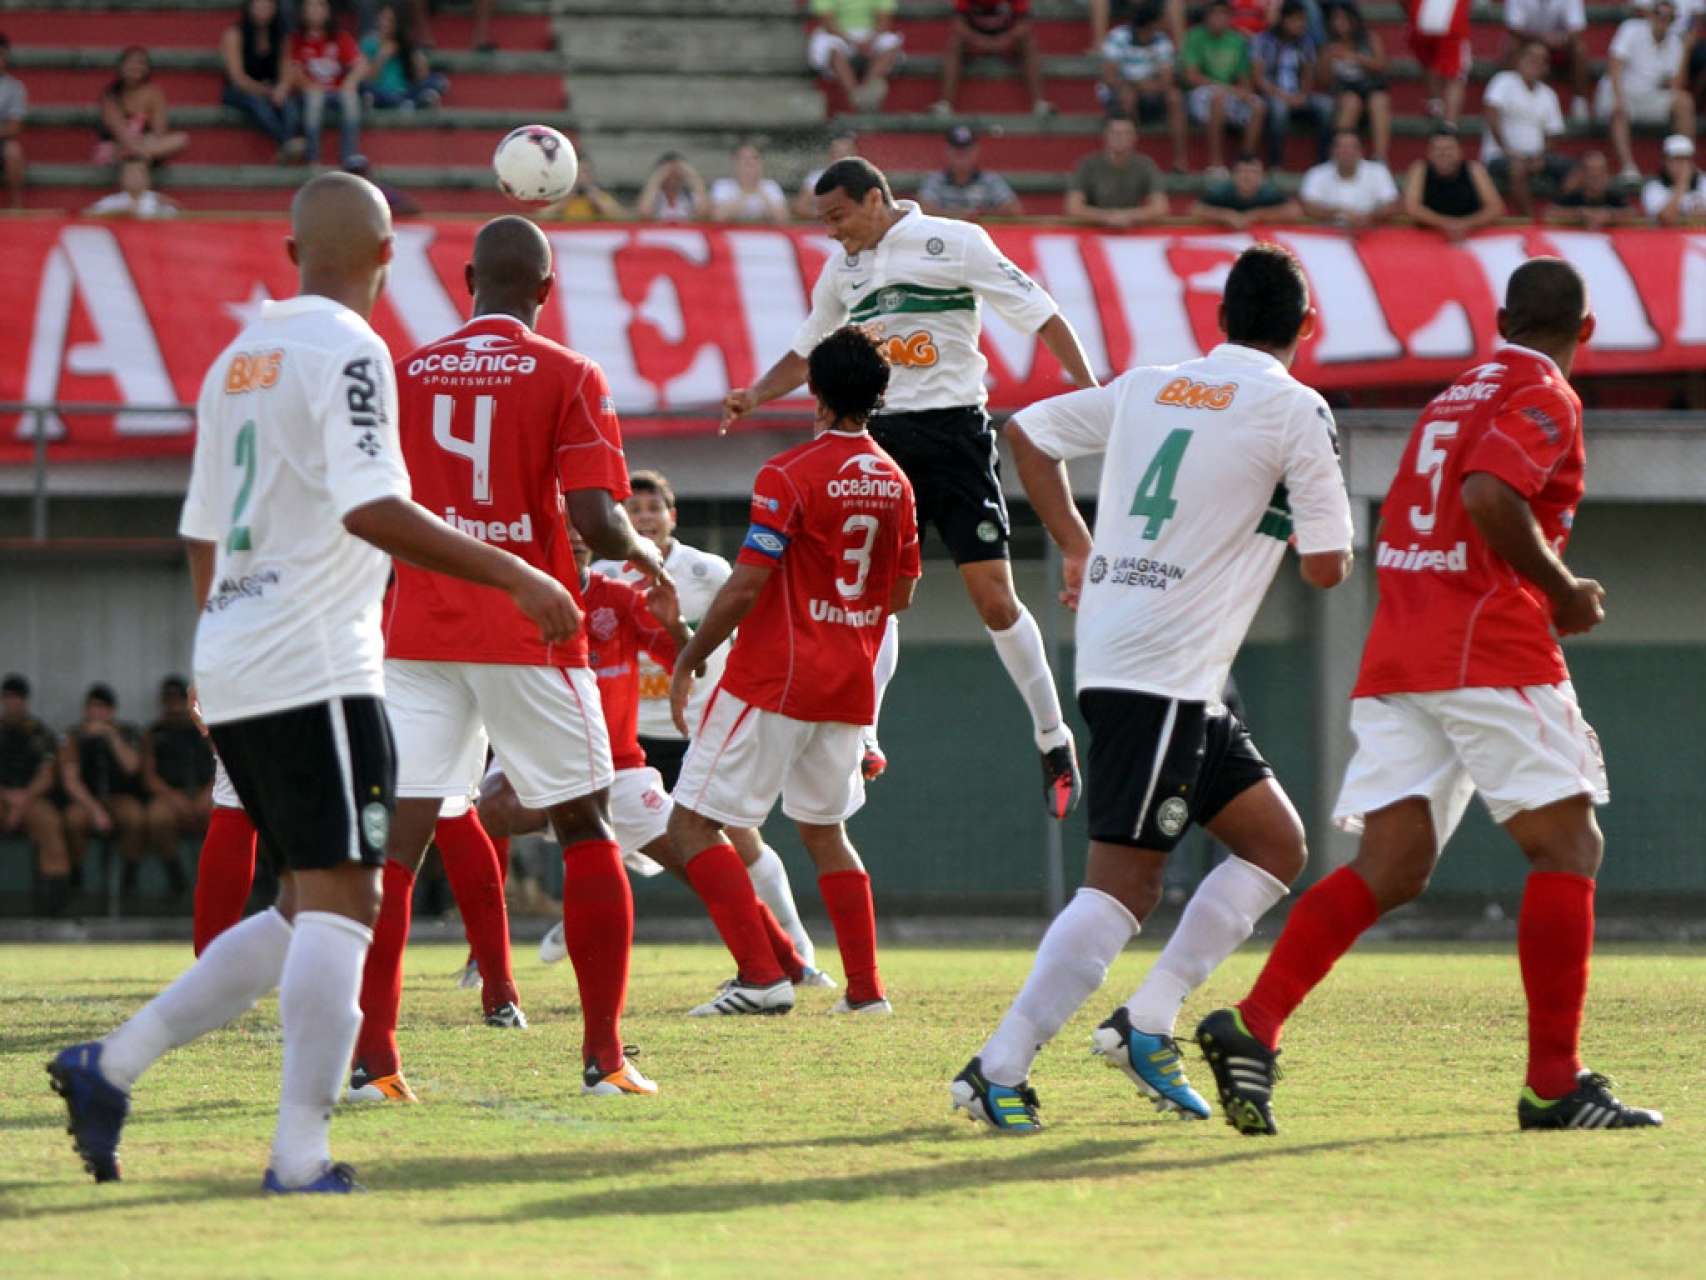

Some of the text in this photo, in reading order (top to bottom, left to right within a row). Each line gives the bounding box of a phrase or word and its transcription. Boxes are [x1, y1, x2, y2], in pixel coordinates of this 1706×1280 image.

[15, 225, 195, 440] A
[408, 351, 537, 376] oceânica
[880, 330, 939, 368] MG
[423, 376, 513, 386] SPORTSWEAR
[1155, 376, 1239, 411] BMG
[431, 393, 498, 506] 4
[1408, 420, 1460, 535] 5
[226, 417, 257, 556] 2
[826, 475, 903, 500] oceânica
[1128, 427, 1195, 541] 4
[443, 506, 534, 543] imed
[834, 513, 880, 601] 3
